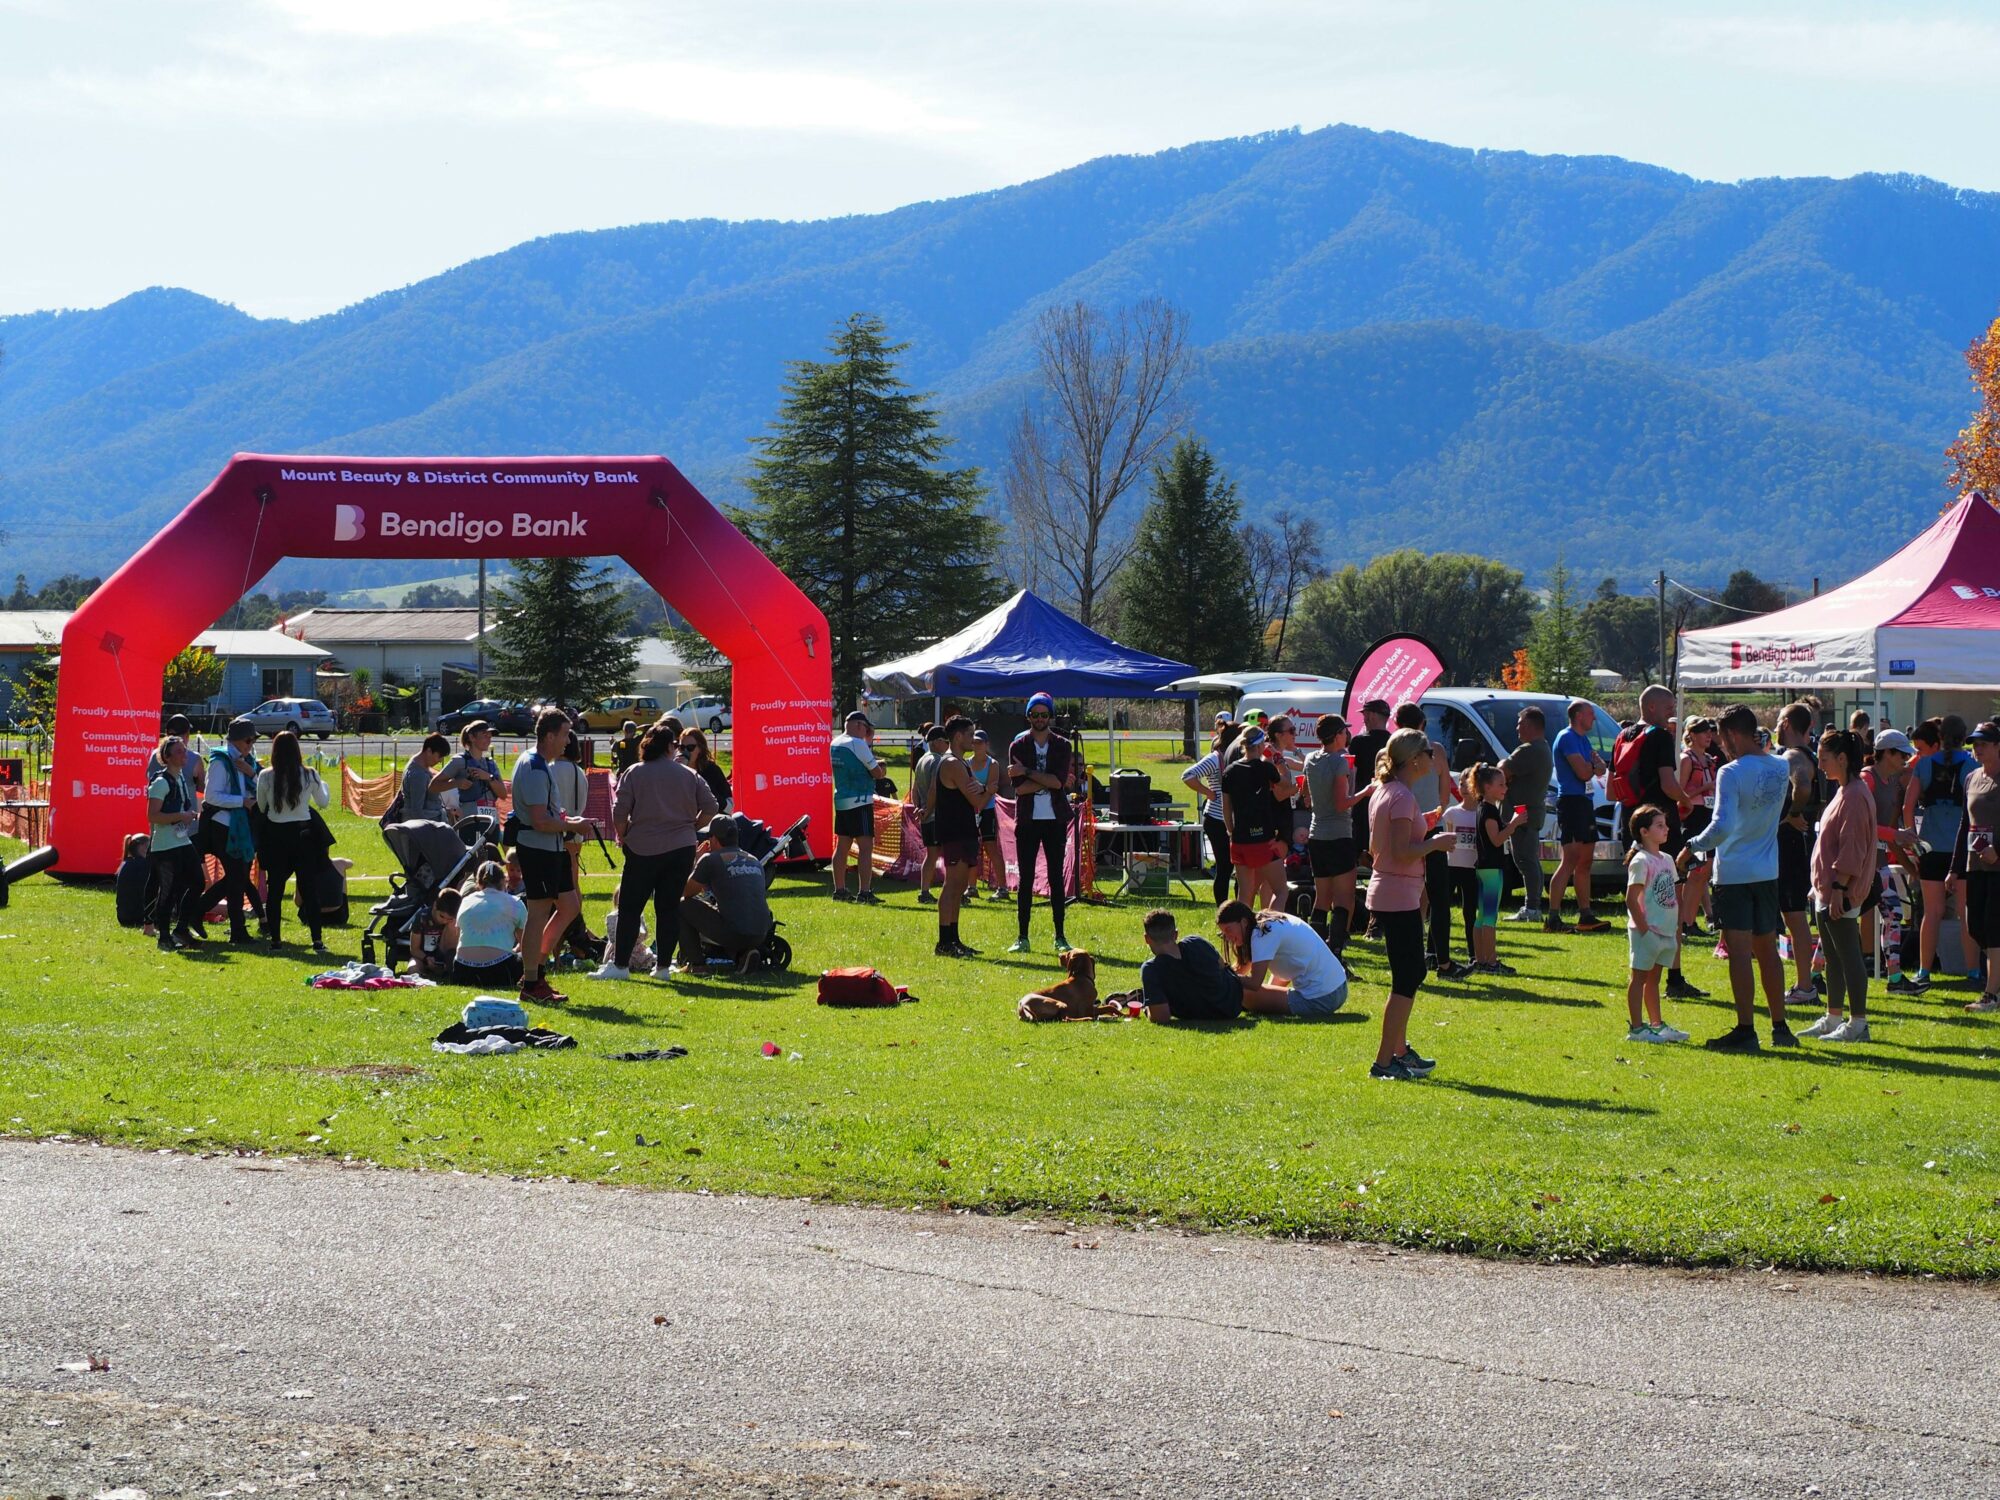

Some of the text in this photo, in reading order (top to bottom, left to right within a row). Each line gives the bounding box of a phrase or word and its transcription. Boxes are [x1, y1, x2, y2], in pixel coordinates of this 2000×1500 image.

[281, 469, 639, 486] Mount Beauty & District Community Bank
[380, 511, 503, 543] Bendigo
[512, 511, 588, 537] Bank
[1745, 642, 1816, 671] Bendigo Bank
[1357, 647, 1403, 704] Community Bank
[1410, 667, 1431, 687] Bank
[72, 706, 110, 718] Proudly
[112, 709, 156, 718] supported
[751, 700, 786, 712] Proudly
[762, 722, 815, 734] Community
[82, 731, 139, 743] Community
[765, 735, 796, 745] Mount
[799, 734, 826, 745] Beauty
[85, 744, 150, 756] Mount Beauty
[787, 747, 820, 756] District
[107, 757, 142, 766] District
[773, 772, 821, 787] Bendigo
[91, 784, 142, 800] Bendigo
